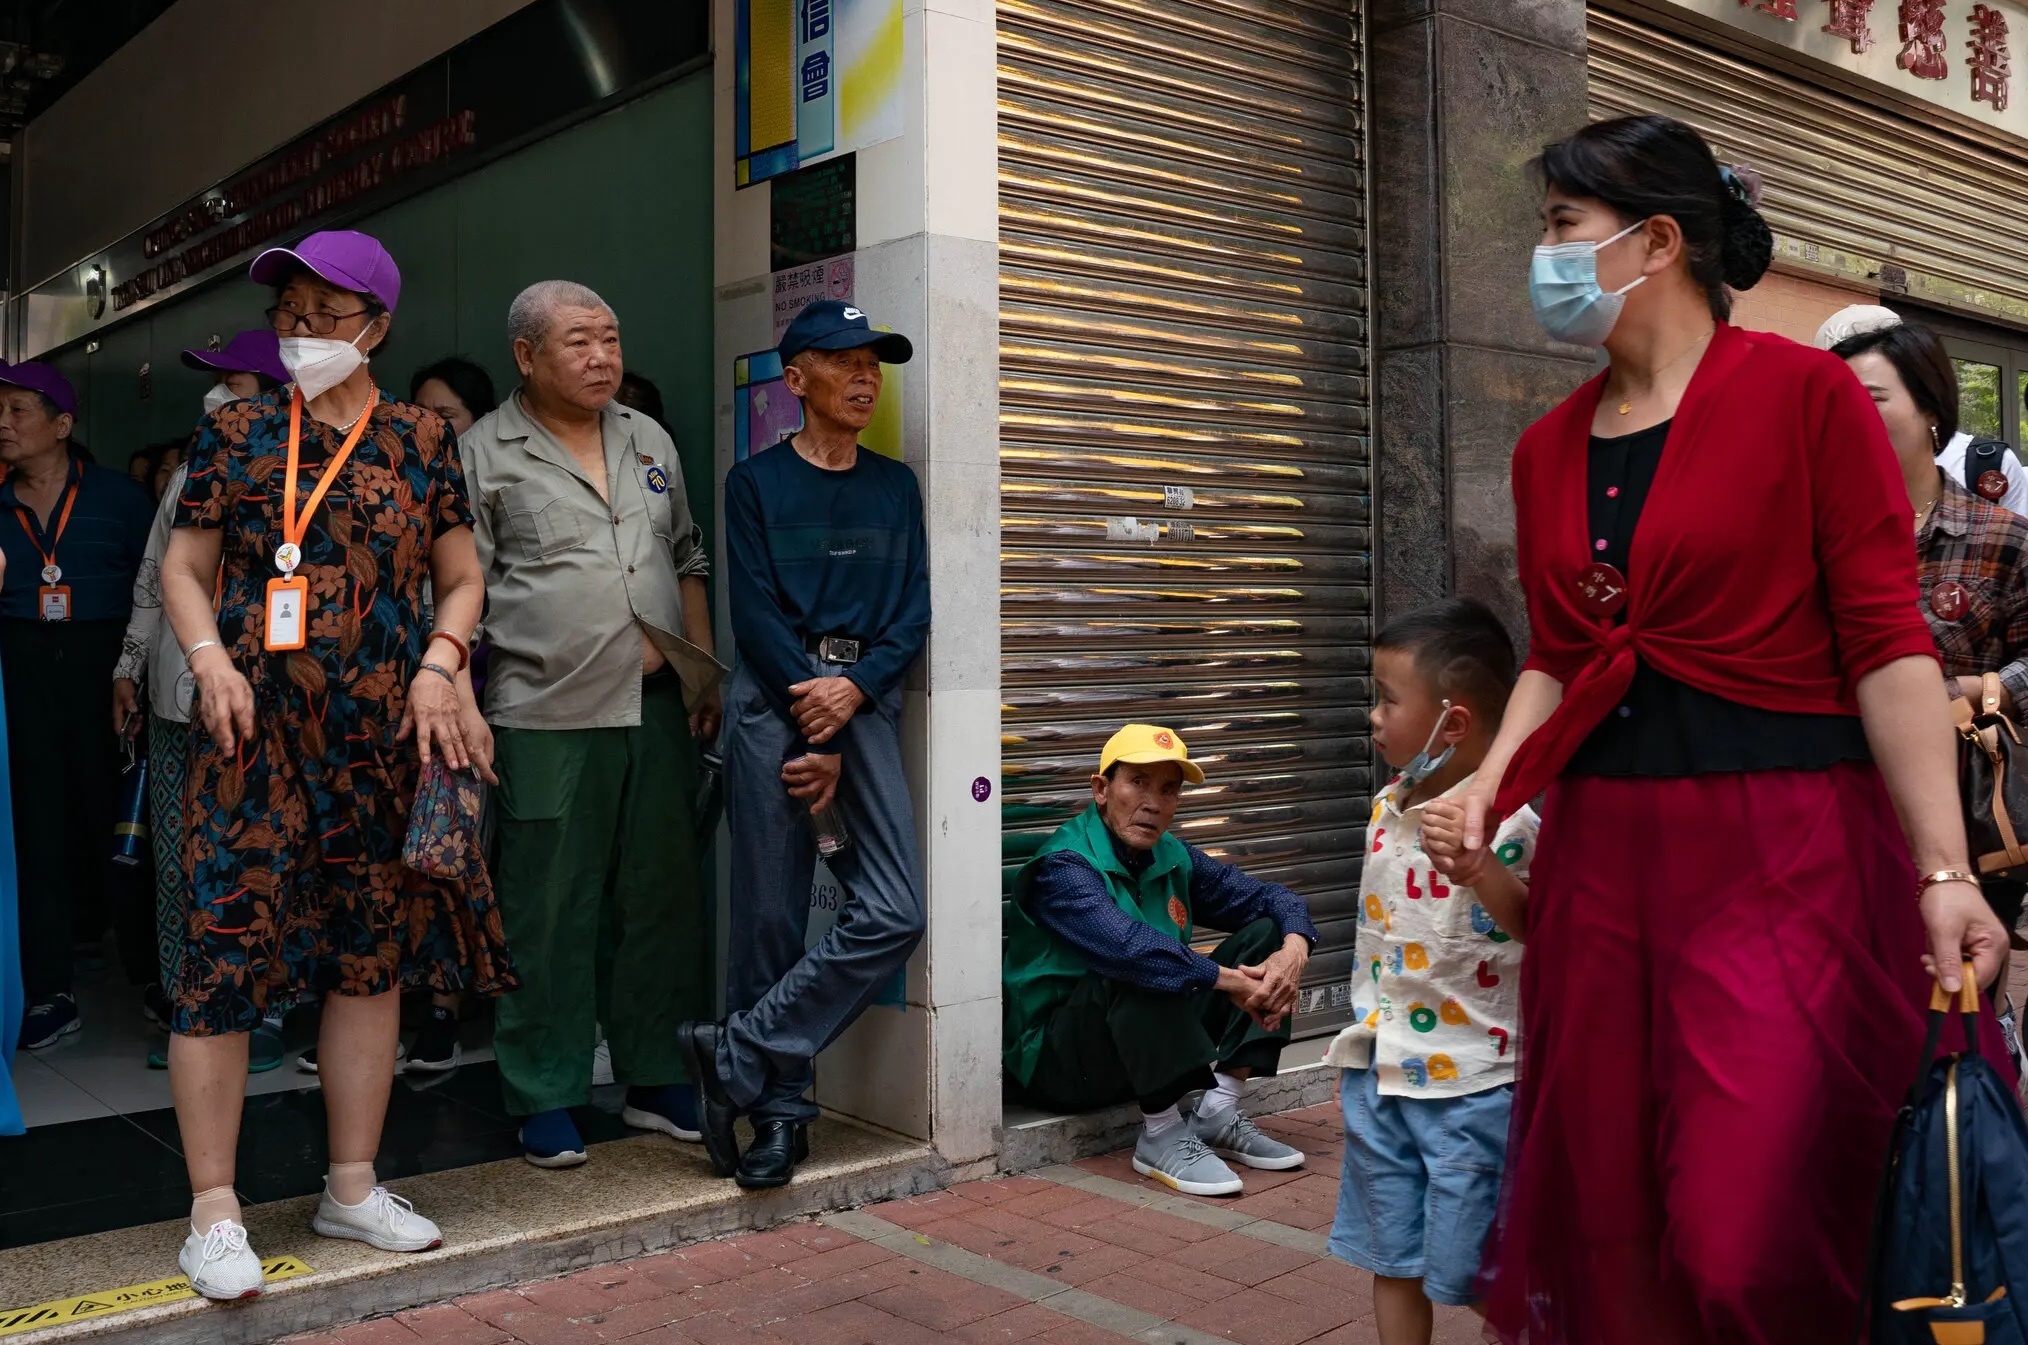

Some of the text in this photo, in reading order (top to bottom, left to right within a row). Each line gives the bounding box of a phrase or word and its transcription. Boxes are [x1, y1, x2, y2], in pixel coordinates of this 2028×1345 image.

[775, 265, 824, 293] 嚴禁吸煙
[775, 291, 826, 312] NO SMOKING
[652, 475, 665, 491] 70
